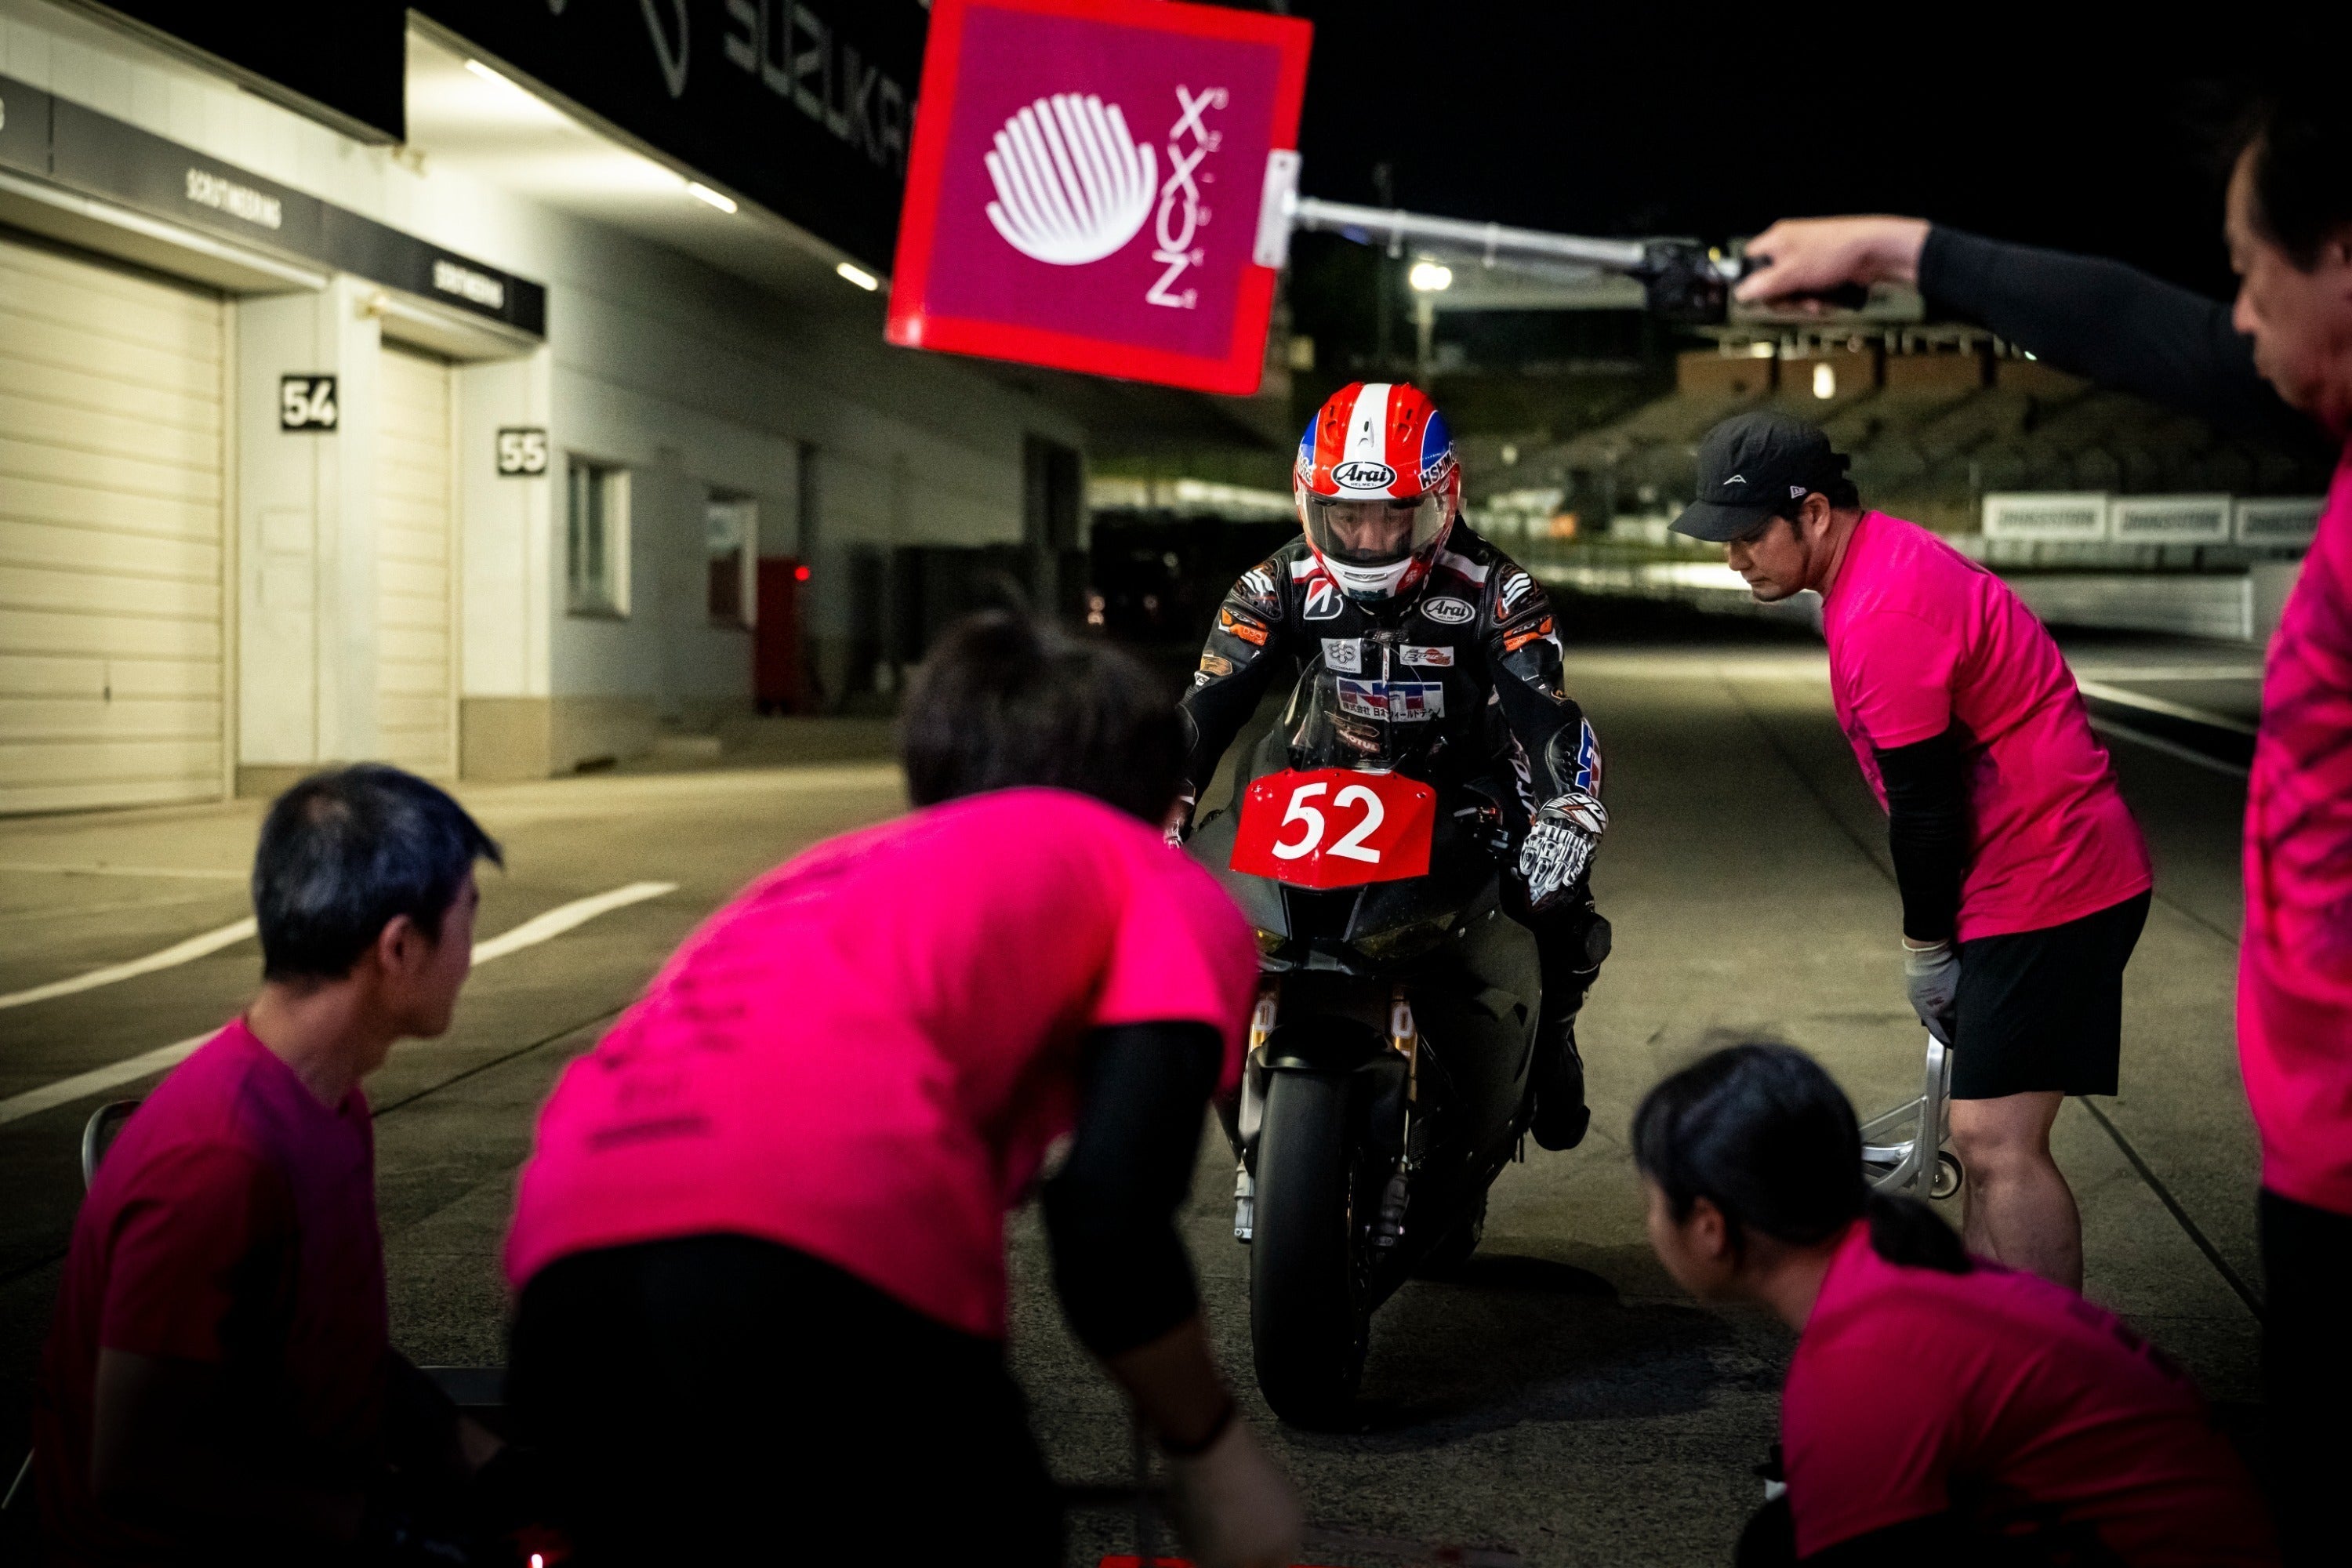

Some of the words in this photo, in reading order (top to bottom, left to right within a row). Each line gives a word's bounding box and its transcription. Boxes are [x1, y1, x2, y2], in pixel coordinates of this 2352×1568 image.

[282, 381, 336, 426] 54
[500, 433, 546, 471] 55
[1337, 464, 1388, 482] Arai
[1428, 601, 1466, 618] Arai
[1343, 703, 1370, 716] 株式会社
[1272, 782, 1385, 864] 52
